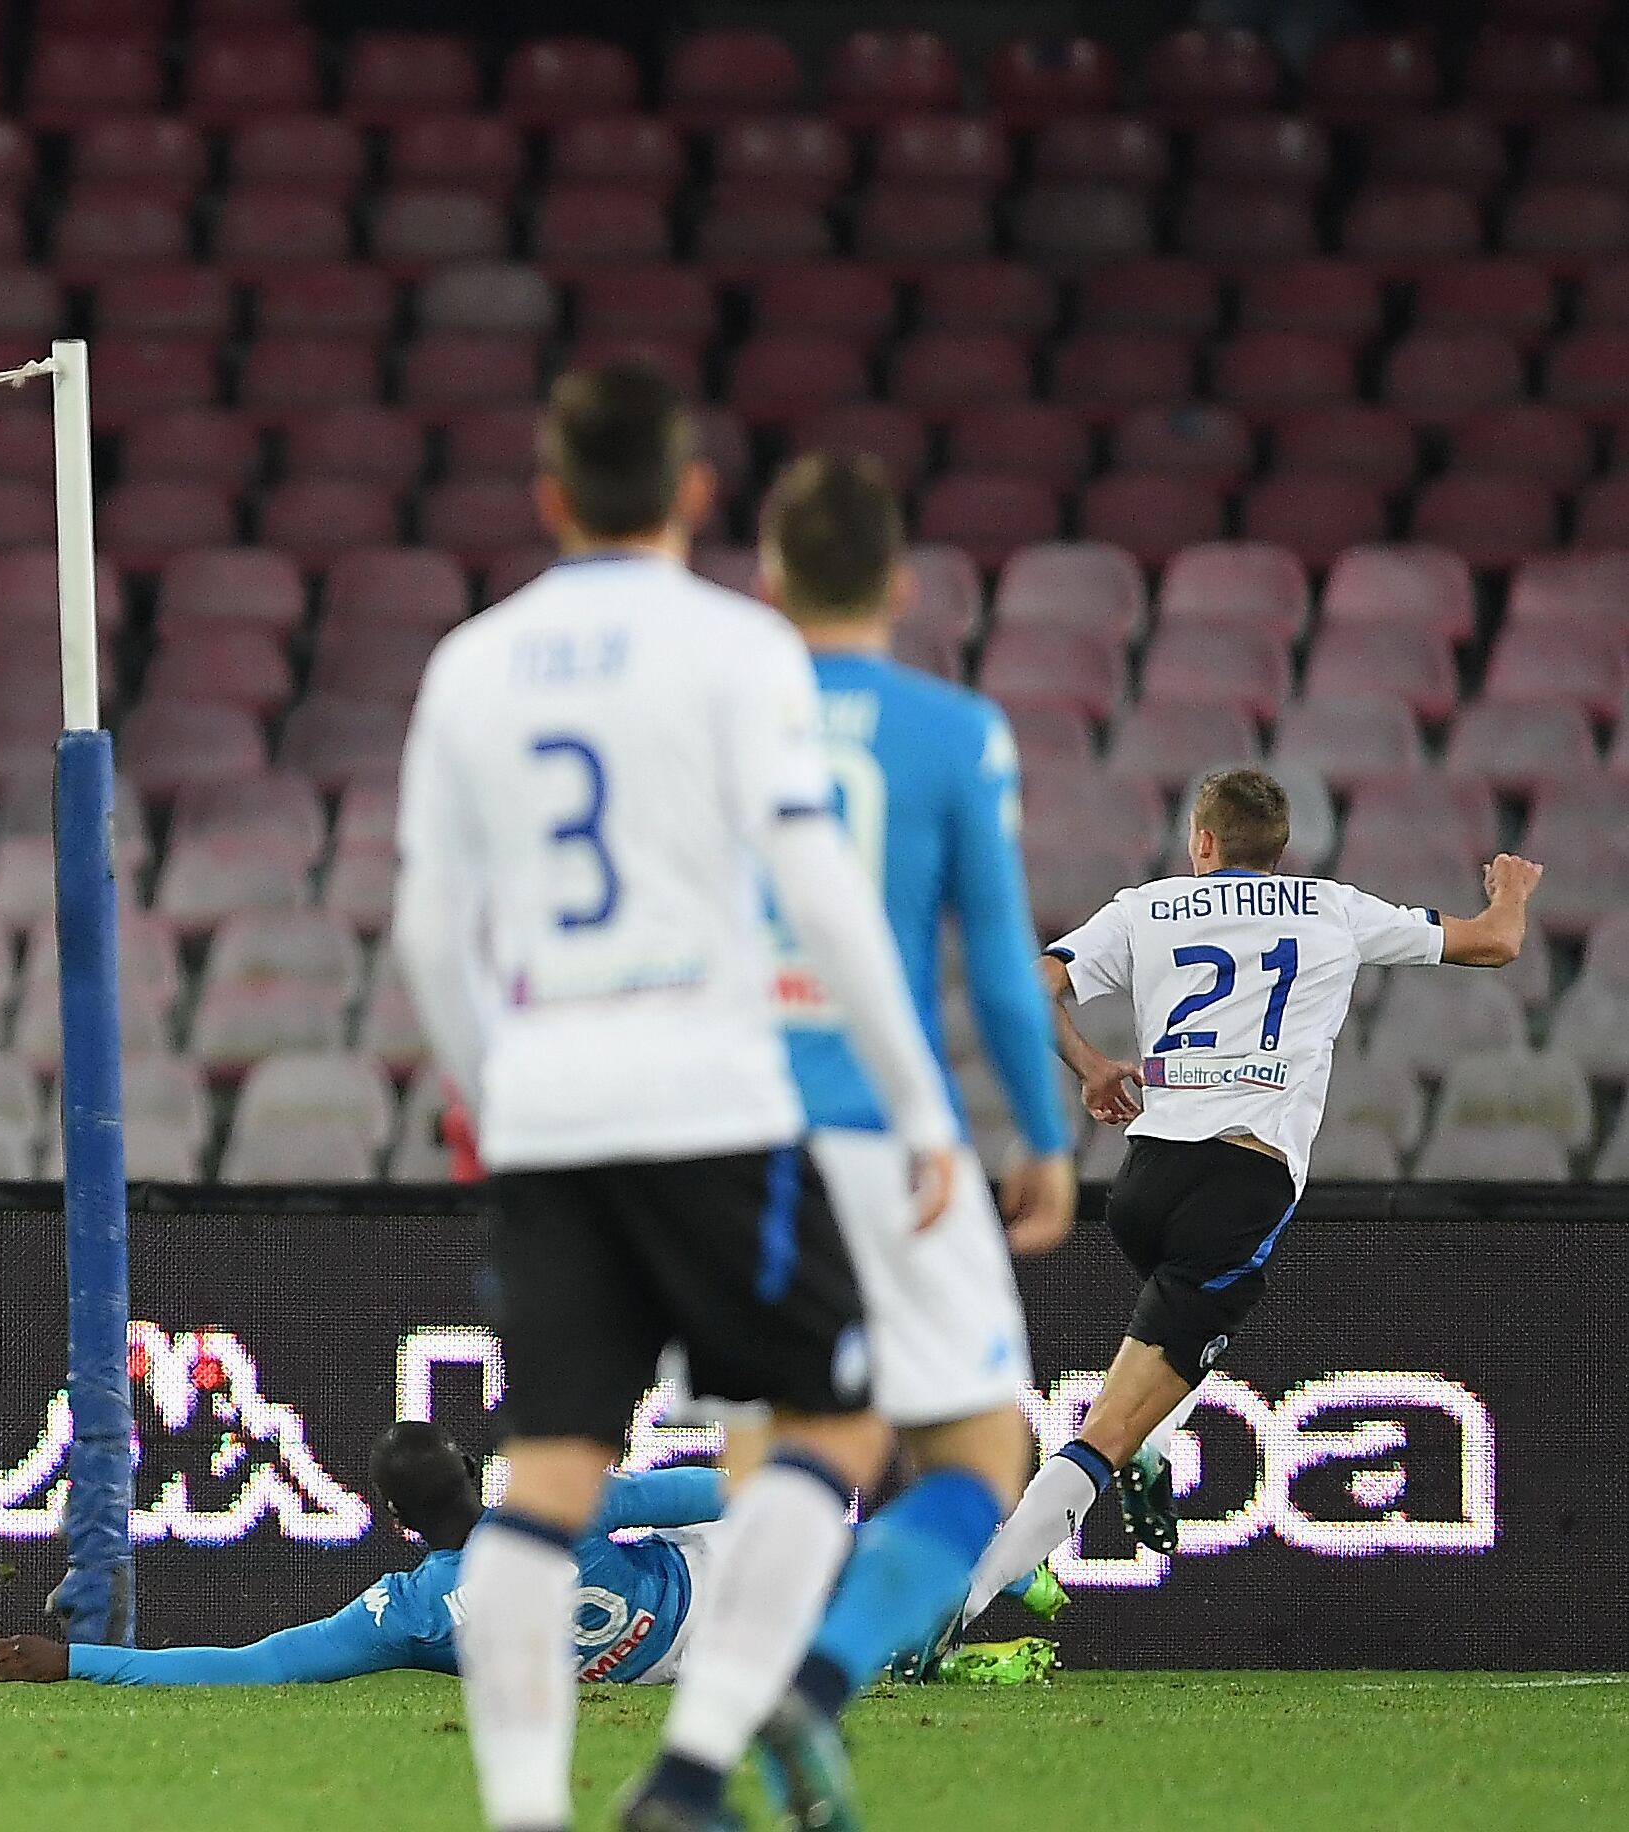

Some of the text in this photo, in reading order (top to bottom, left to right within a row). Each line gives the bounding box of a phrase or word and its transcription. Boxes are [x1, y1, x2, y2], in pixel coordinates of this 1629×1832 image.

[529, 732, 623, 932] 3
[1151, 881, 1318, 920] CASTAGNE
[1153, 938, 1298, 1054] 21
[578, 1615, 654, 1683] MBO
